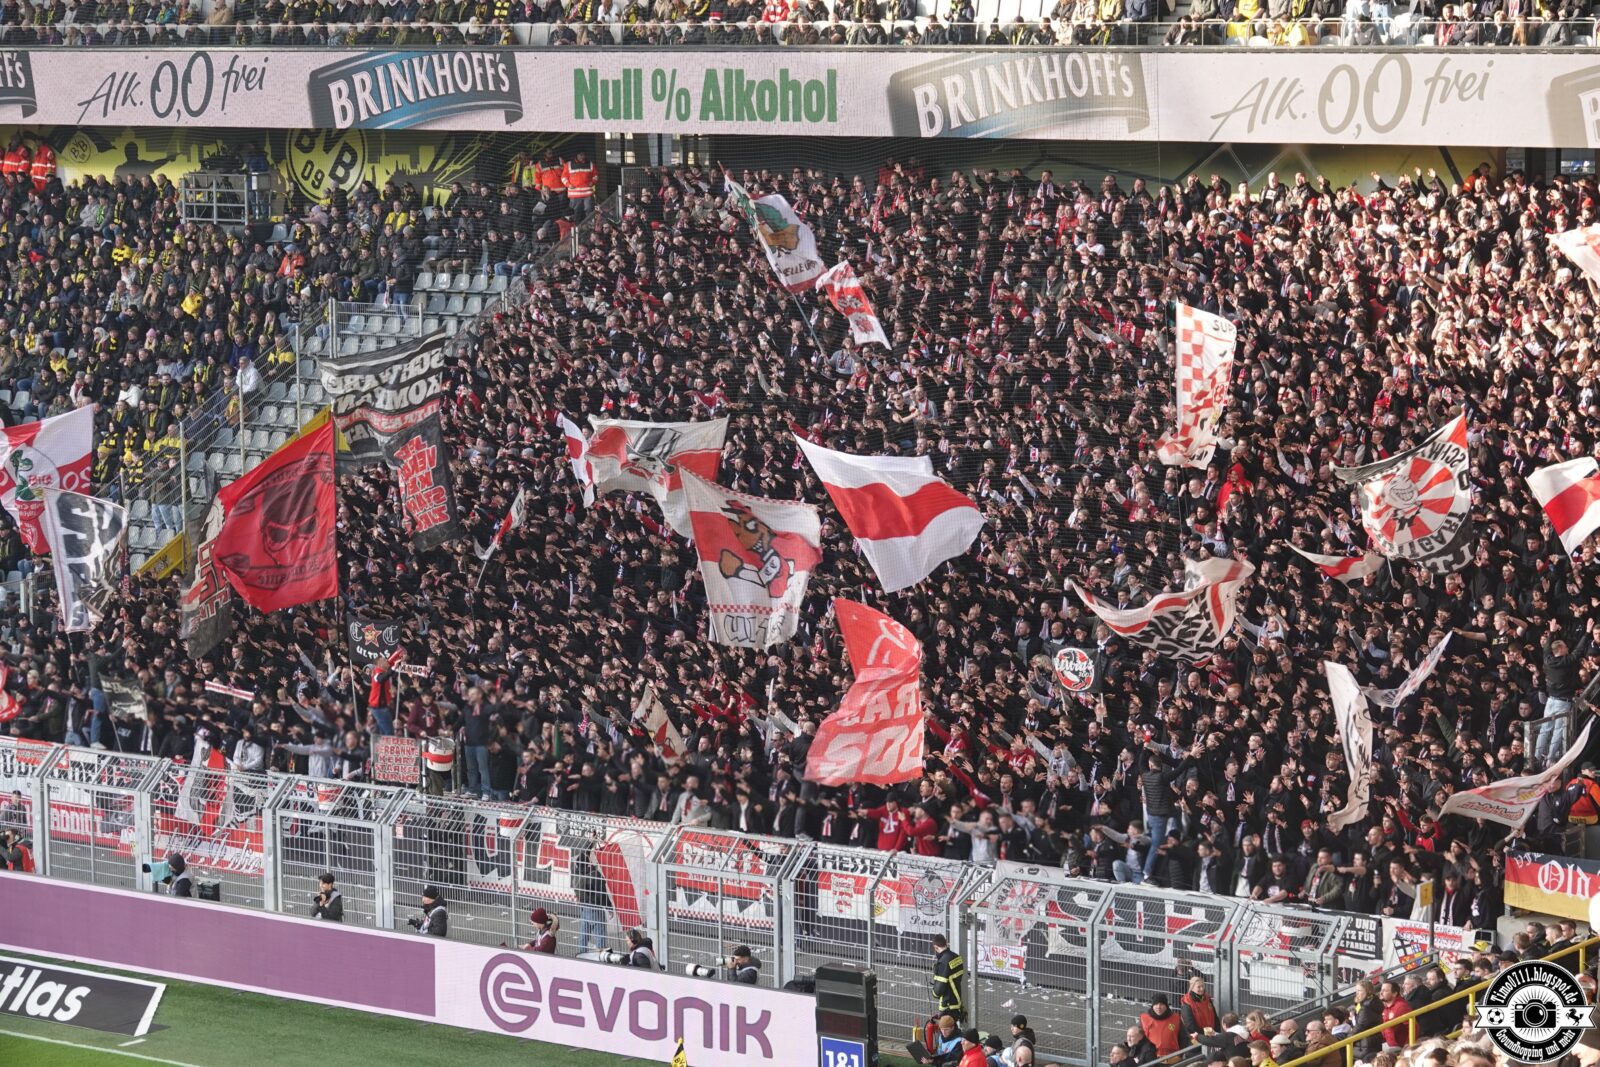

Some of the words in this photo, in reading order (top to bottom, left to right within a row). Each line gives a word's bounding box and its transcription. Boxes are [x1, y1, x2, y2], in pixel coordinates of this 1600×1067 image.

[77, 71, 143, 124] Alk.
[150, 51, 214, 121] 0,0
[221, 54, 269, 115] frei
[328, 52, 510, 129] BRINKHOFF's
[574, 68, 643, 120] Null
[651, 68, 691, 121] %
[699, 68, 838, 122] Alkohol
[912, 52, 1134, 138] BRINKHOFF's
[1208, 77, 1306, 141] Alk.
[1317, 54, 1413, 138] 0,0
[1423, 57, 1495, 126] frei
[301, 159, 325, 189] 09
[821, 853, 899, 879] HESSEN
[1538, 860, 1591, 900] Old
[1355, 918, 1377, 931] UND
[1358, 930, 1375, 943] FÜR
[0, 966, 91, 1021] tlas
[549, 977, 773, 1059] EVONIK
